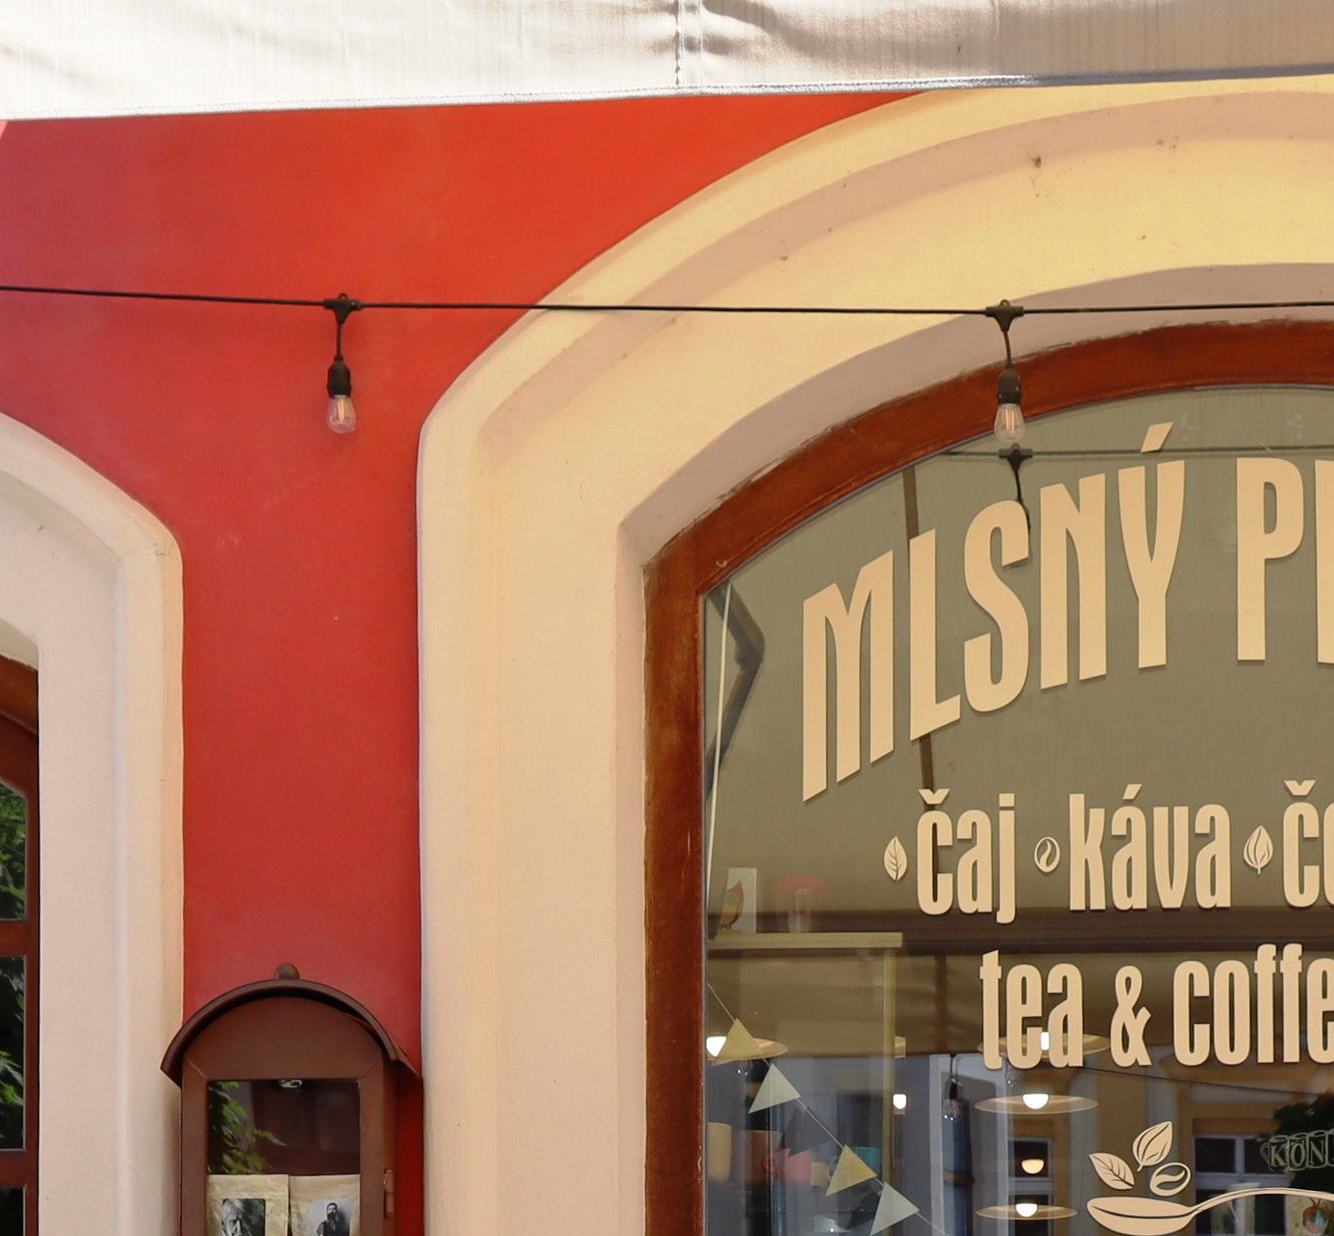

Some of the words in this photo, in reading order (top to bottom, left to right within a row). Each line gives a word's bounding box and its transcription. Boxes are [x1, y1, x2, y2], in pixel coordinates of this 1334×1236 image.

[803, 422, 1184, 802] MLSNÝ
[916, 787, 1015, 924] čaj
[1070, 782, 1230, 910] káva
[980, 950, 1083, 1070] tea
[1110, 964, 1152, 1066] &
